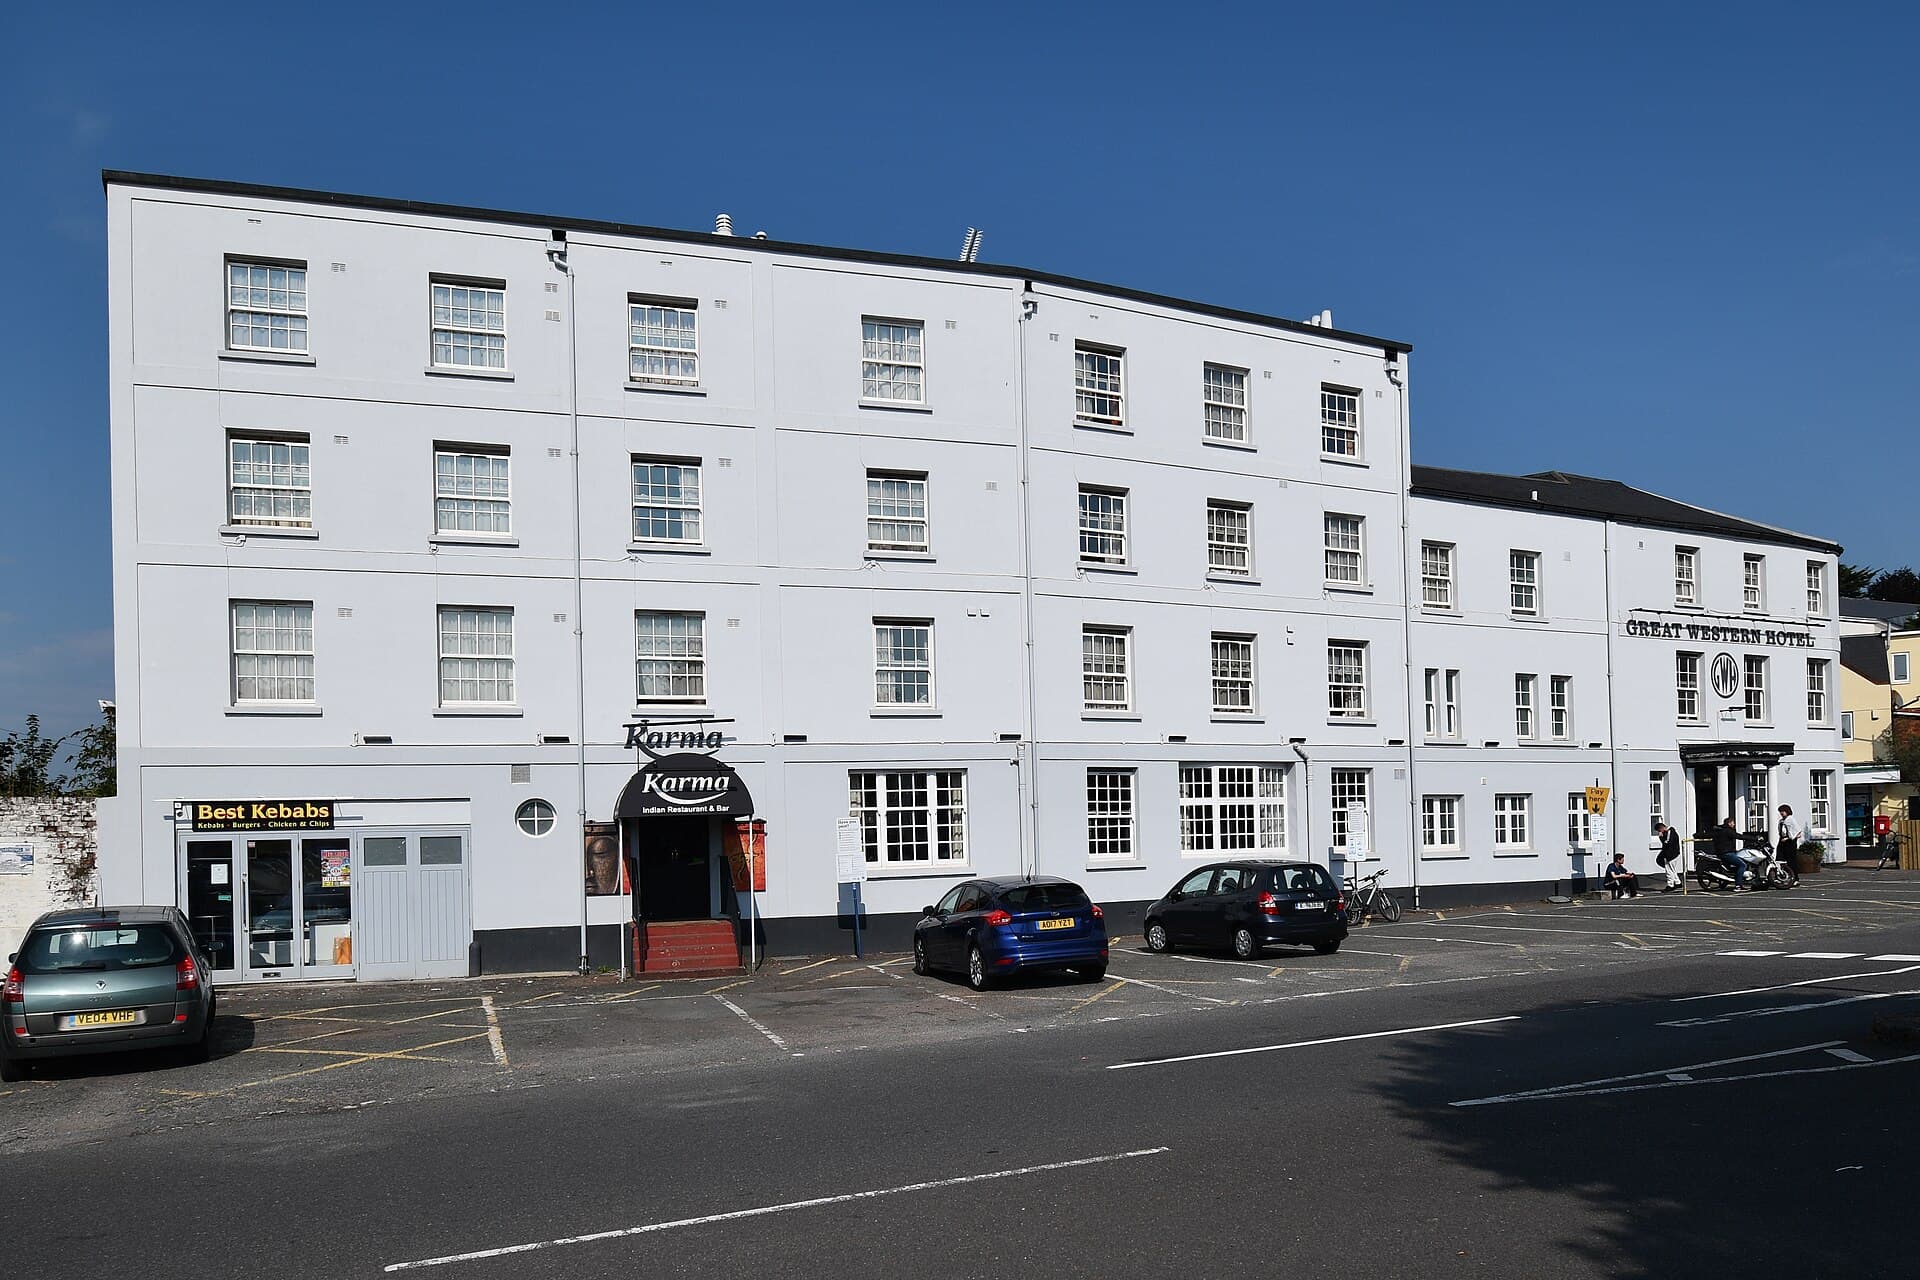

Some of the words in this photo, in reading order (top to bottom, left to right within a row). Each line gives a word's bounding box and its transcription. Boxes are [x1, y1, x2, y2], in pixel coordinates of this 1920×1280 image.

[1626, 619, 1682, 638] GREAT
[1686, 623, 1761, 644] WESTERN
[1765, 630, 1816, 647] HOTEL
[1712, 655, 1738, 695] GWH
[624, 725, 723, 749] Karma
[642, 773, 730, 793] Karma
[1590, 788, 1604, 796] Pay
[197, 804, 245, 819] Best
[251, 803, 329, 819] Kebabs
[642, 806, 665, 814] Indian
[667, 805, 707, 814] Restaurant
[232, 821, 261, 829] Burgers
[268, 820, 297, 828] Chicken
[309, 820, 330, 828] Chips
[78, 1012, 108, 1024] VE04
[111, 1011, 133, 1021] VHF
